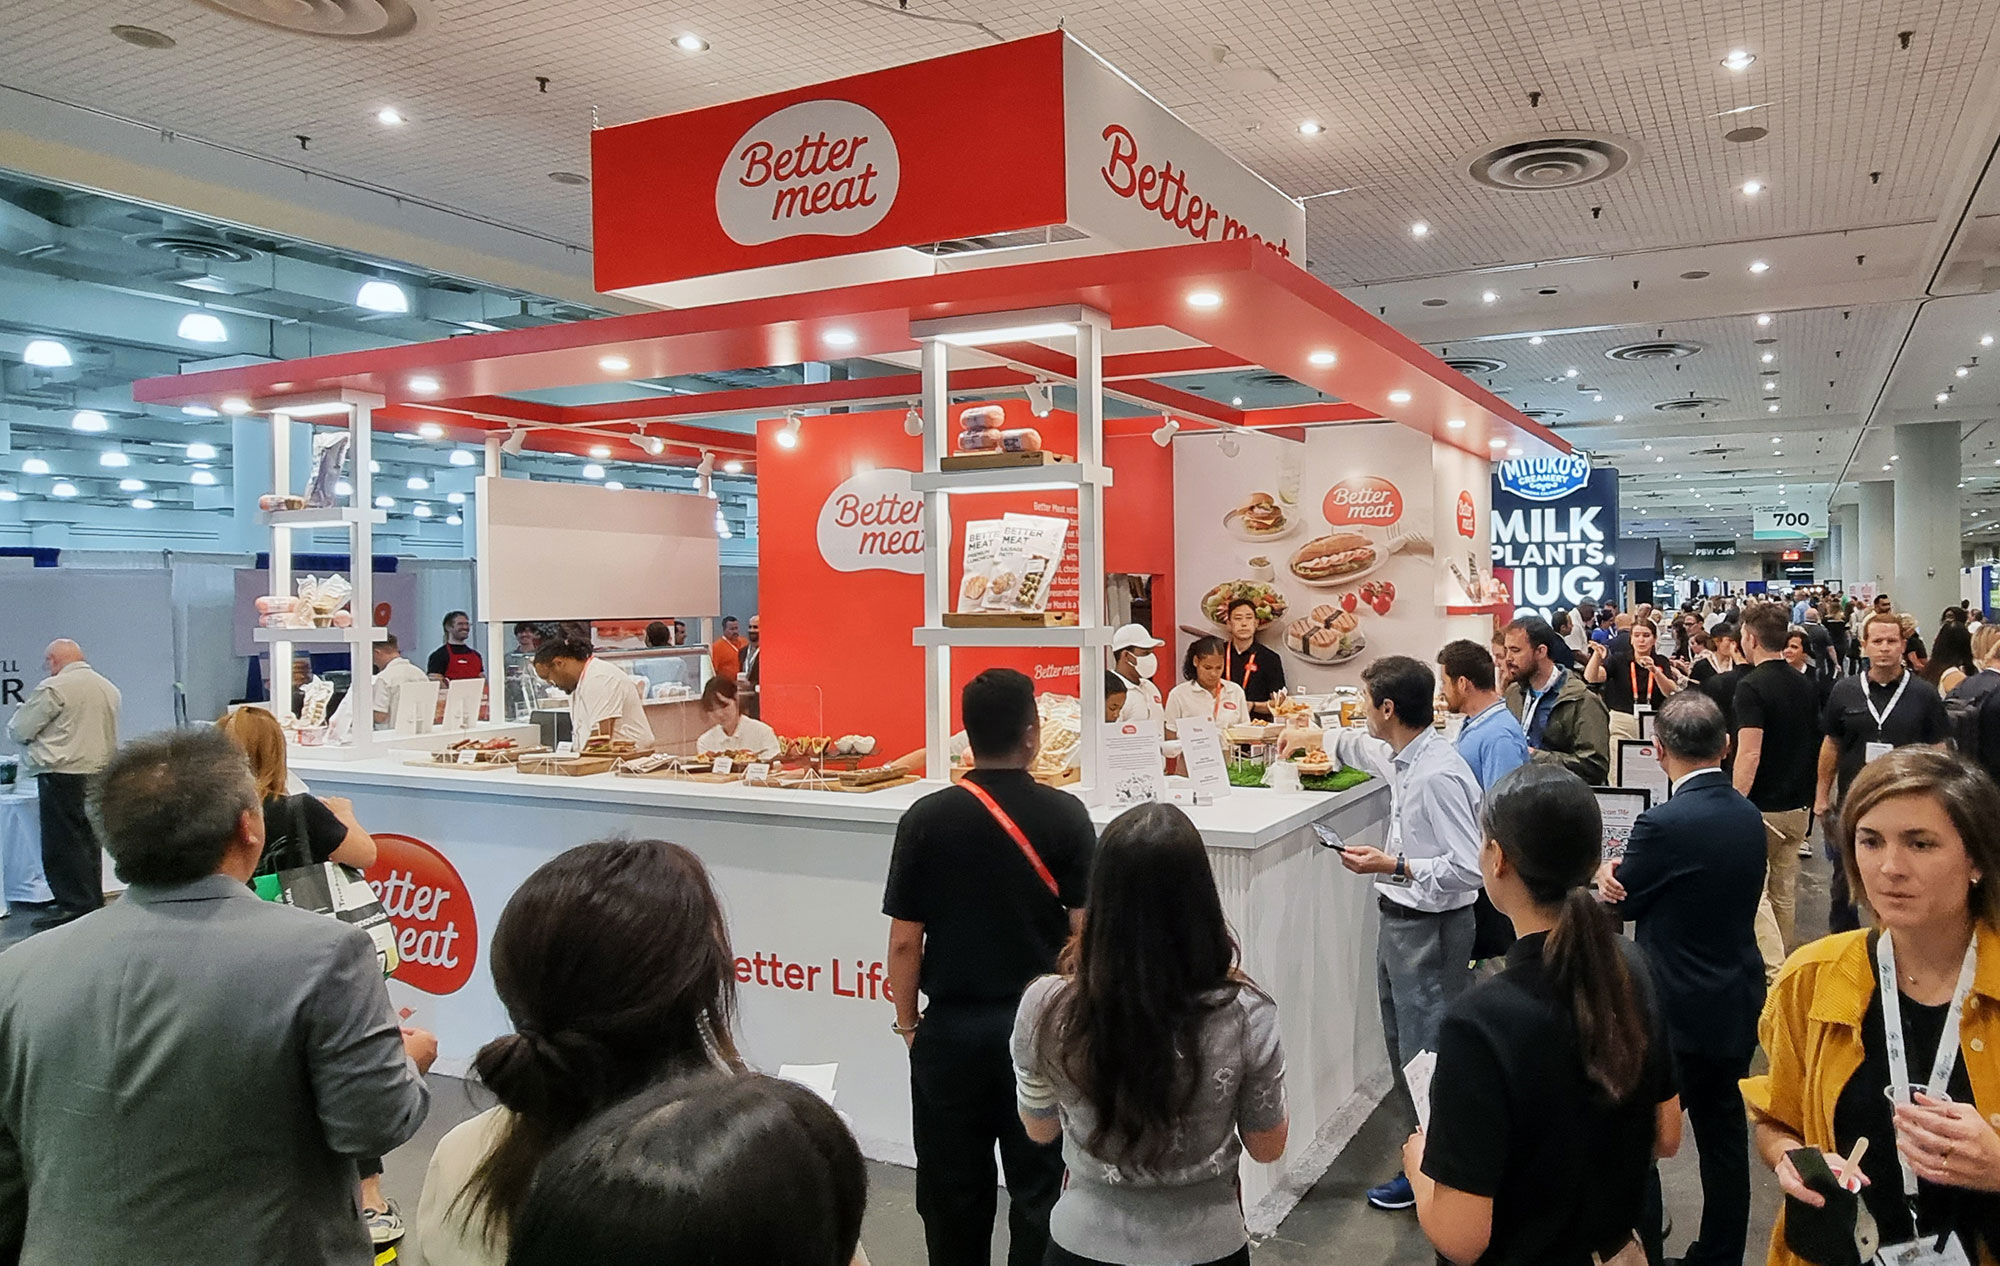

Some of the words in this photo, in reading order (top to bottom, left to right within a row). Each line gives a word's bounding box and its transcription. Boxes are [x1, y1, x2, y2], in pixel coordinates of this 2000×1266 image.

[739, 131, 868, 187] Better
[772, 163, 878, 220] meat
[1101, 124, 1218, 241] Better
[1518, 474, 1569, 486] CREAMERY
[1333, 488, 1391, 506] Better
[835, 493, 924, 527] Better
[1346, 501, 1395, 518] meat
[1773, 512, 1809, 527] 700
[969, 530, 1000, 542] BETTE
[1004, 526, 1044, 538] BETTER
[1490, 506, 1604, 544] MILK
[859, 529, 924, 554] mea
[968, 539, 994, 551] MEAT
[1001, 536, 1030, 545] MEAT
[1490, 543, 1615, 566] PLANTS.
[1034, 664, 1061, 680] Better
[1062, 664, 1080, 676] mea
[357, 868, 451, 922] etter
[392, 921, 460, 969] eat
[733, 952, 822, 992] etter
